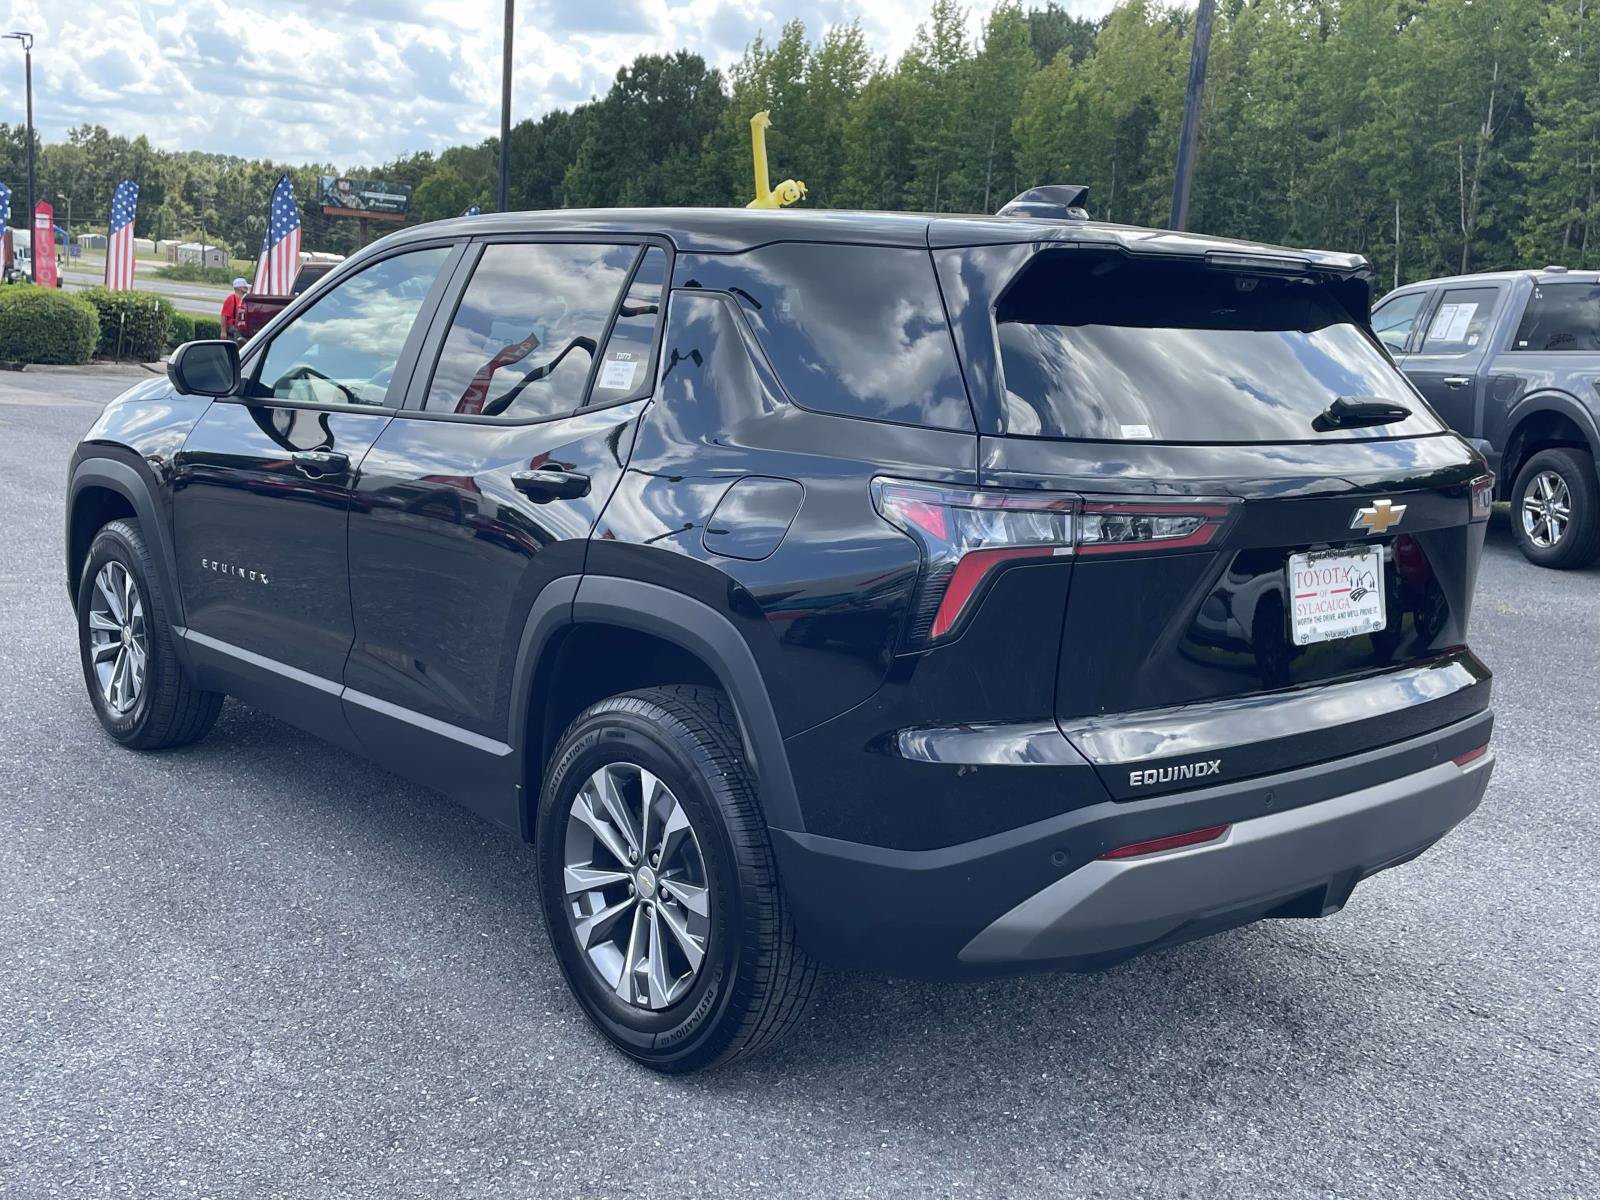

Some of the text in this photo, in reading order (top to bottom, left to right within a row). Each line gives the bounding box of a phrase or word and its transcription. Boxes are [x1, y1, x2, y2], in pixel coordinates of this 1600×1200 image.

[202, 558, 269, 584] EQUINOX
[1295, 567, 1349, 589] TOYOTA
[1296, 598, 1351, 617] SYLACAUGA
[1297, 617, 1312, 626] WORTH
[1313, 615, 1322, 623] THE
[549, 741, 585, 796] DESTINATION
[1129, 759, 1221, 787] EQUINOX
[670, 988, 715, 1042] DESTINATION
